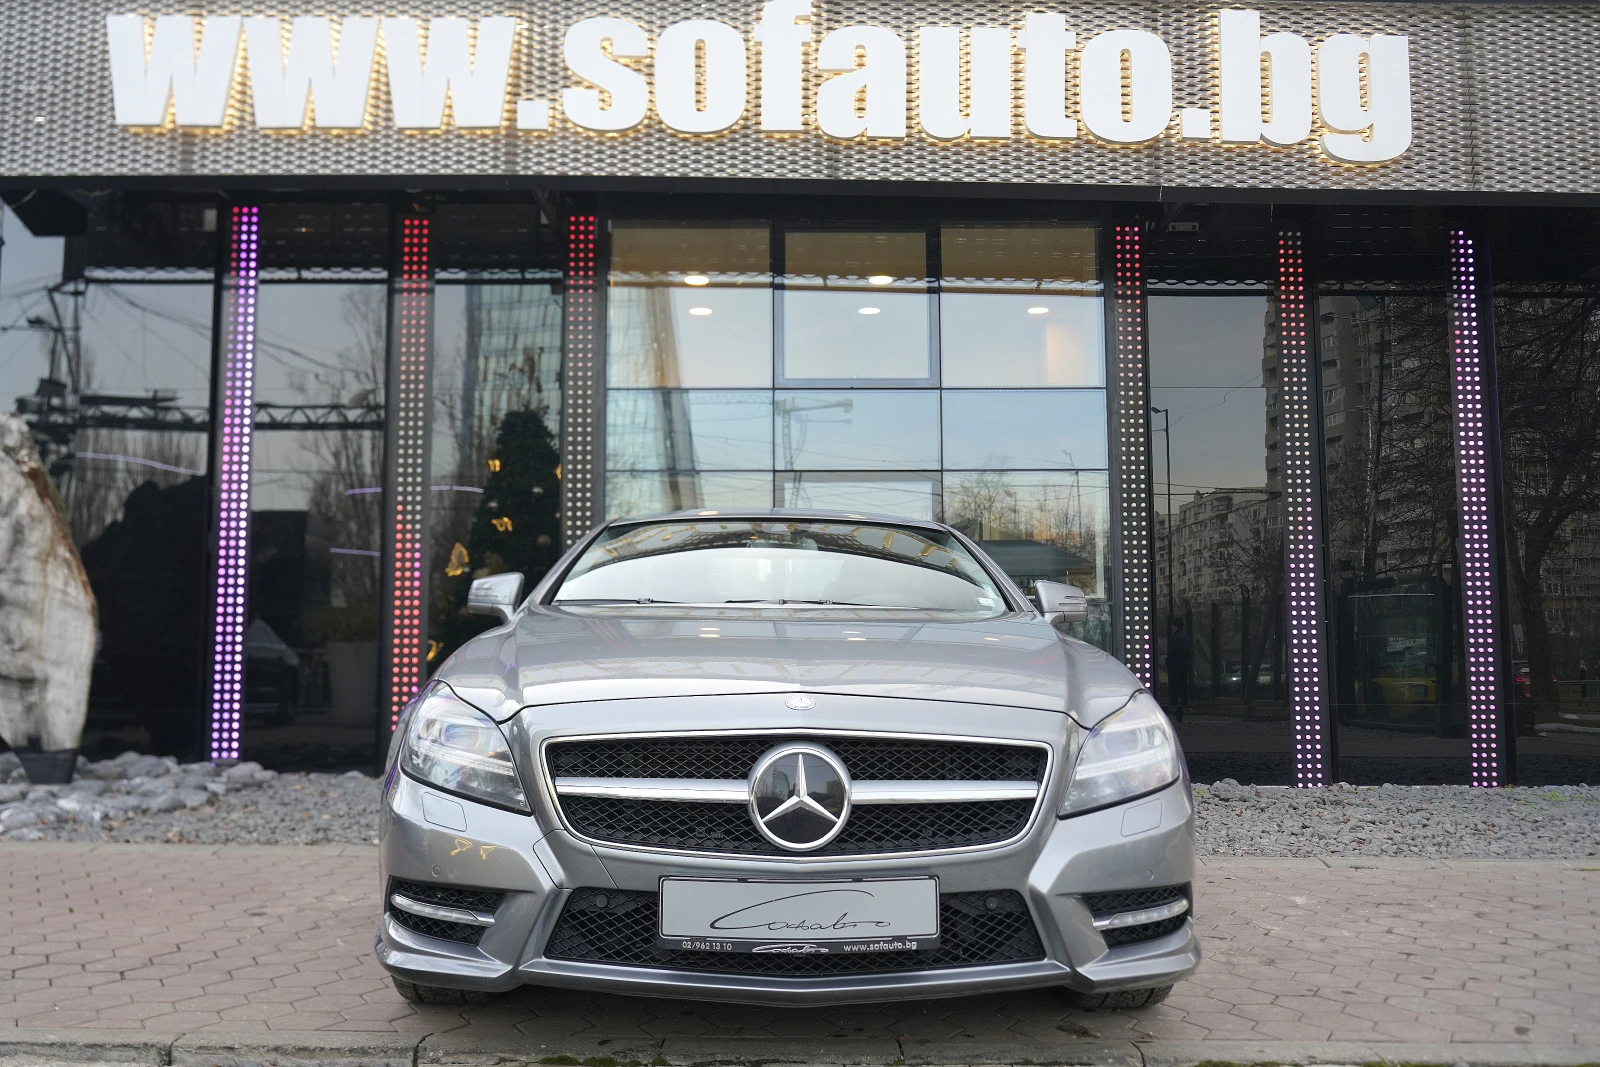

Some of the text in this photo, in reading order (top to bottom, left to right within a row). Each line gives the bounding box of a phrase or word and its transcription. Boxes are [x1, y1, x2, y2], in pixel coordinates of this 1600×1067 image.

[106, 0, 1413, 164] www.sofauto.bg
[682, 941, 732, 951] 02/962 13 10
[843, 940, 917, 952] www.sofauto.bg
